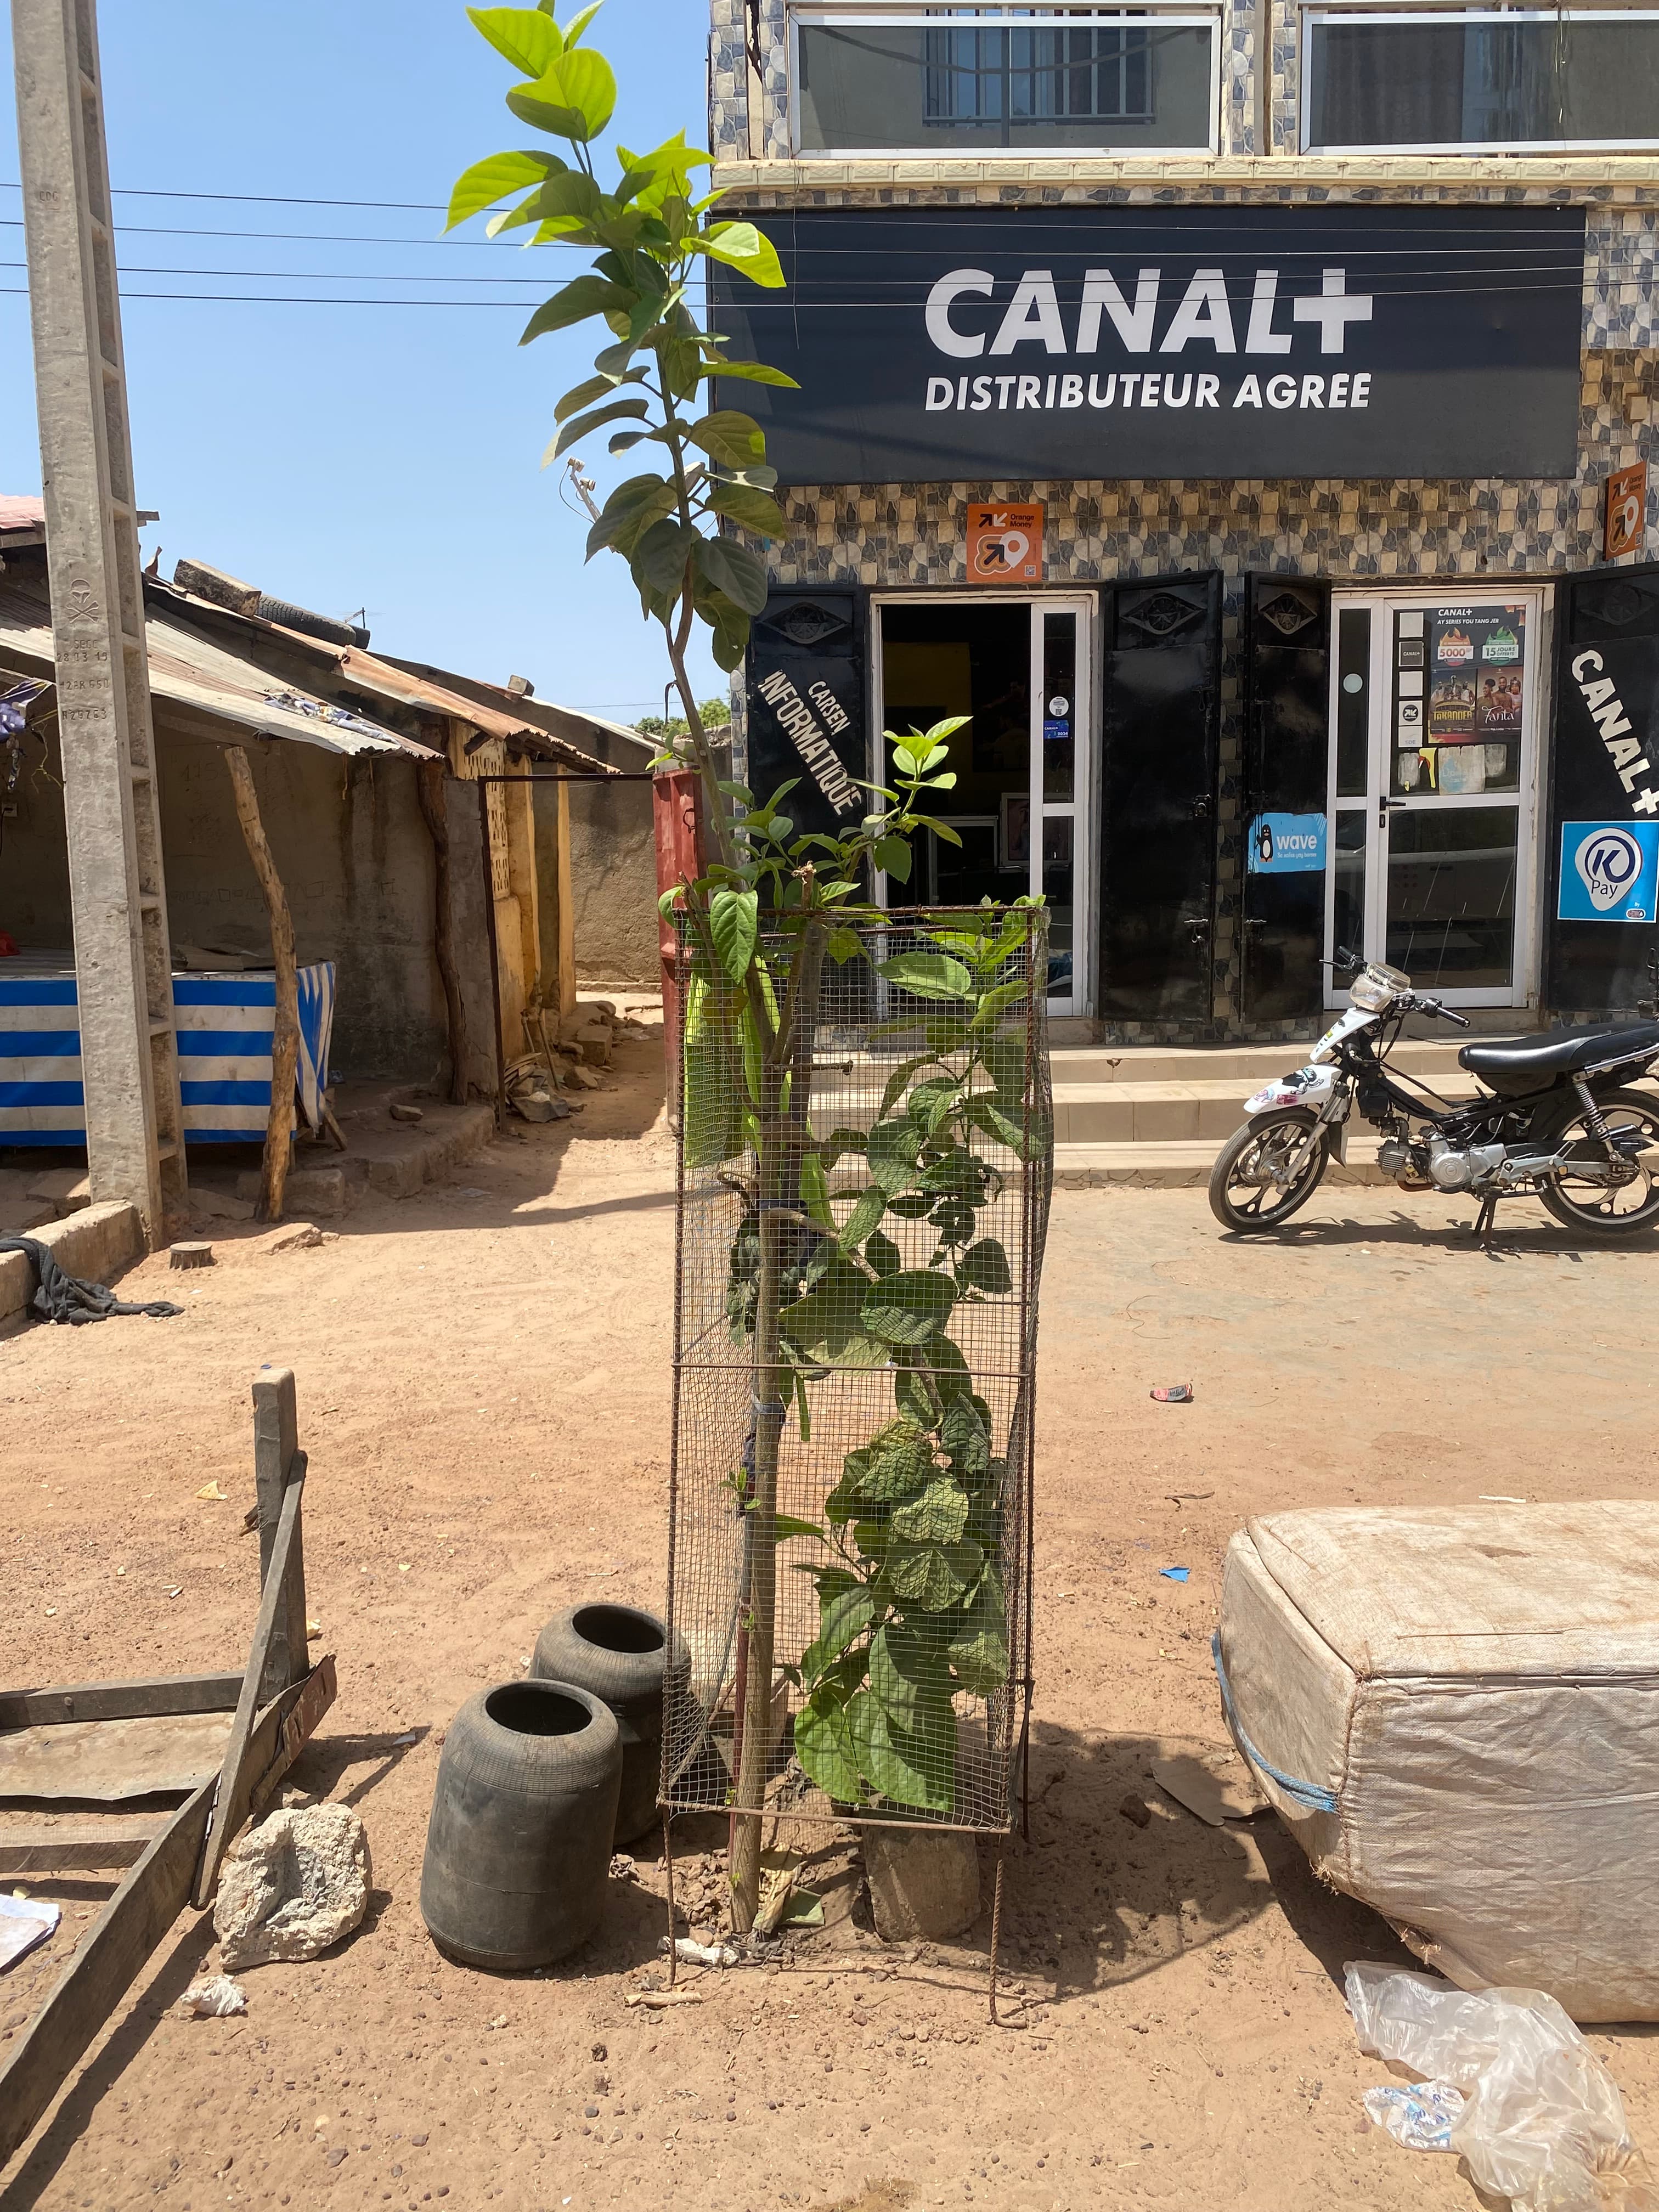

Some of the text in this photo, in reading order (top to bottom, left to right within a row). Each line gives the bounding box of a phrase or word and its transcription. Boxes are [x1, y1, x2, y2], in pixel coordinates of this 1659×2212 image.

[924, 268, 1373, 358] CANAL+
[925, 373, 1220, 411] DISTRIBUTEUR
[1010, 514, 1035, 522] Orange
[1439, 648, 1466, 657] 5000
[1486, 647, 1496, 657] 15
[808, 680, 851, 736] CARSEN
[1481, 706, 1515, 724] Fanta
[758, 669, 862, 816] INFORMATIQUE
[1572, 650, 1659, 815] CANAL+
[1276, 835, 1317, 850] wave
[1591, 879, 1618, 899] Pay
